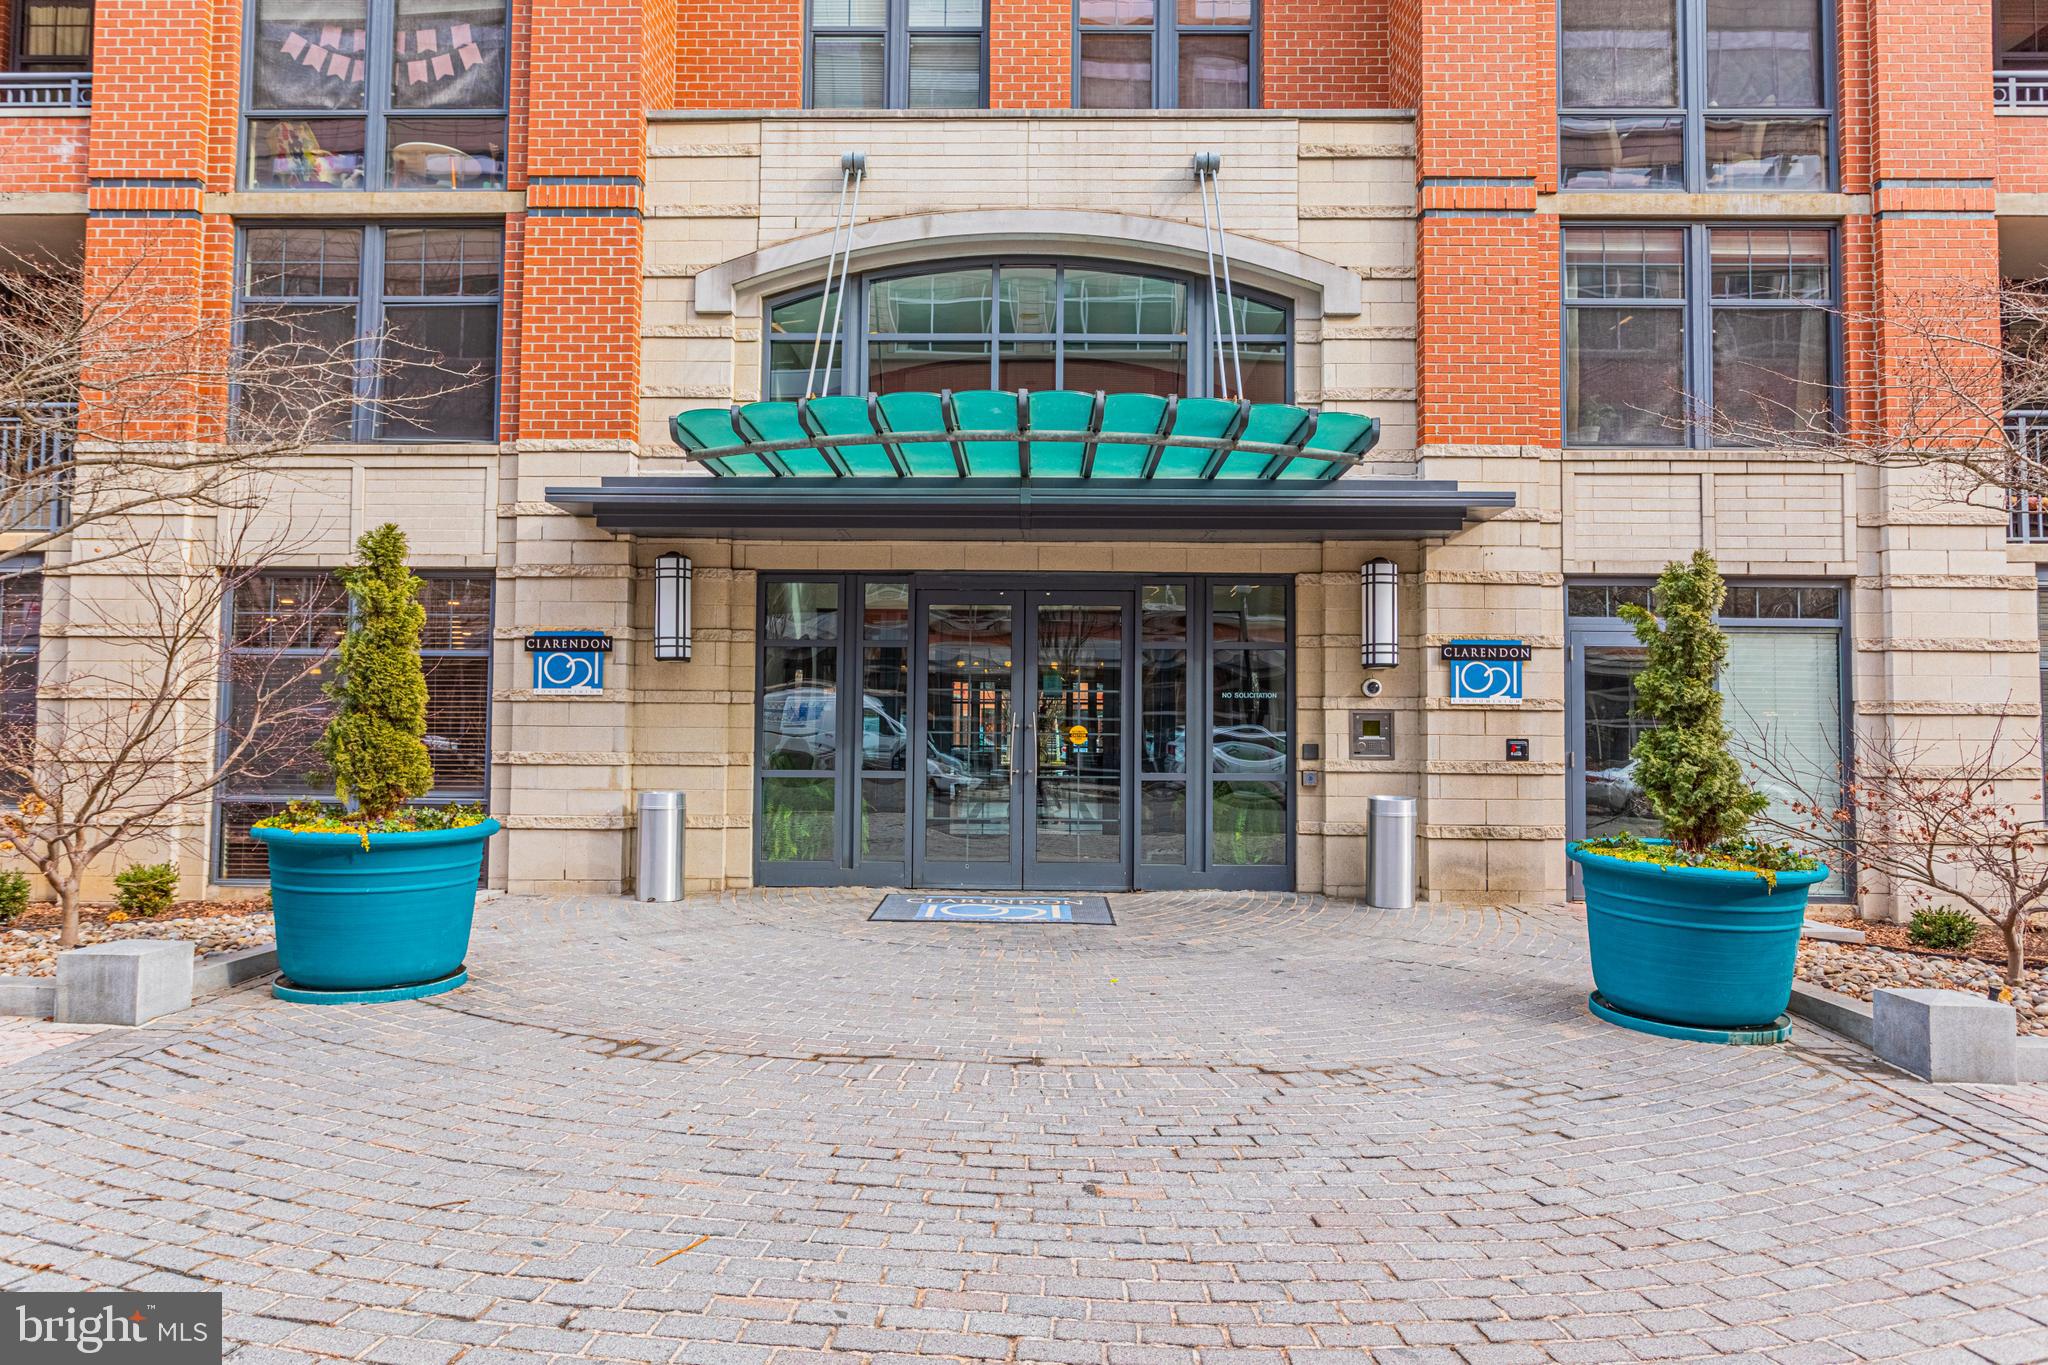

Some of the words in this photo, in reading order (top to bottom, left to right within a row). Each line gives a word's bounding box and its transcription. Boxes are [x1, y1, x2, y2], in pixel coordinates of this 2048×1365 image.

[526, 638, 611, 649] CLARENDON
[1443, 647, 1531, 658] CLARENDON
[538, 652, 599, 689] 1021
[1455, 661, 1518, 699] 1021
[906, 897, 1083, 906] CLARENDON
